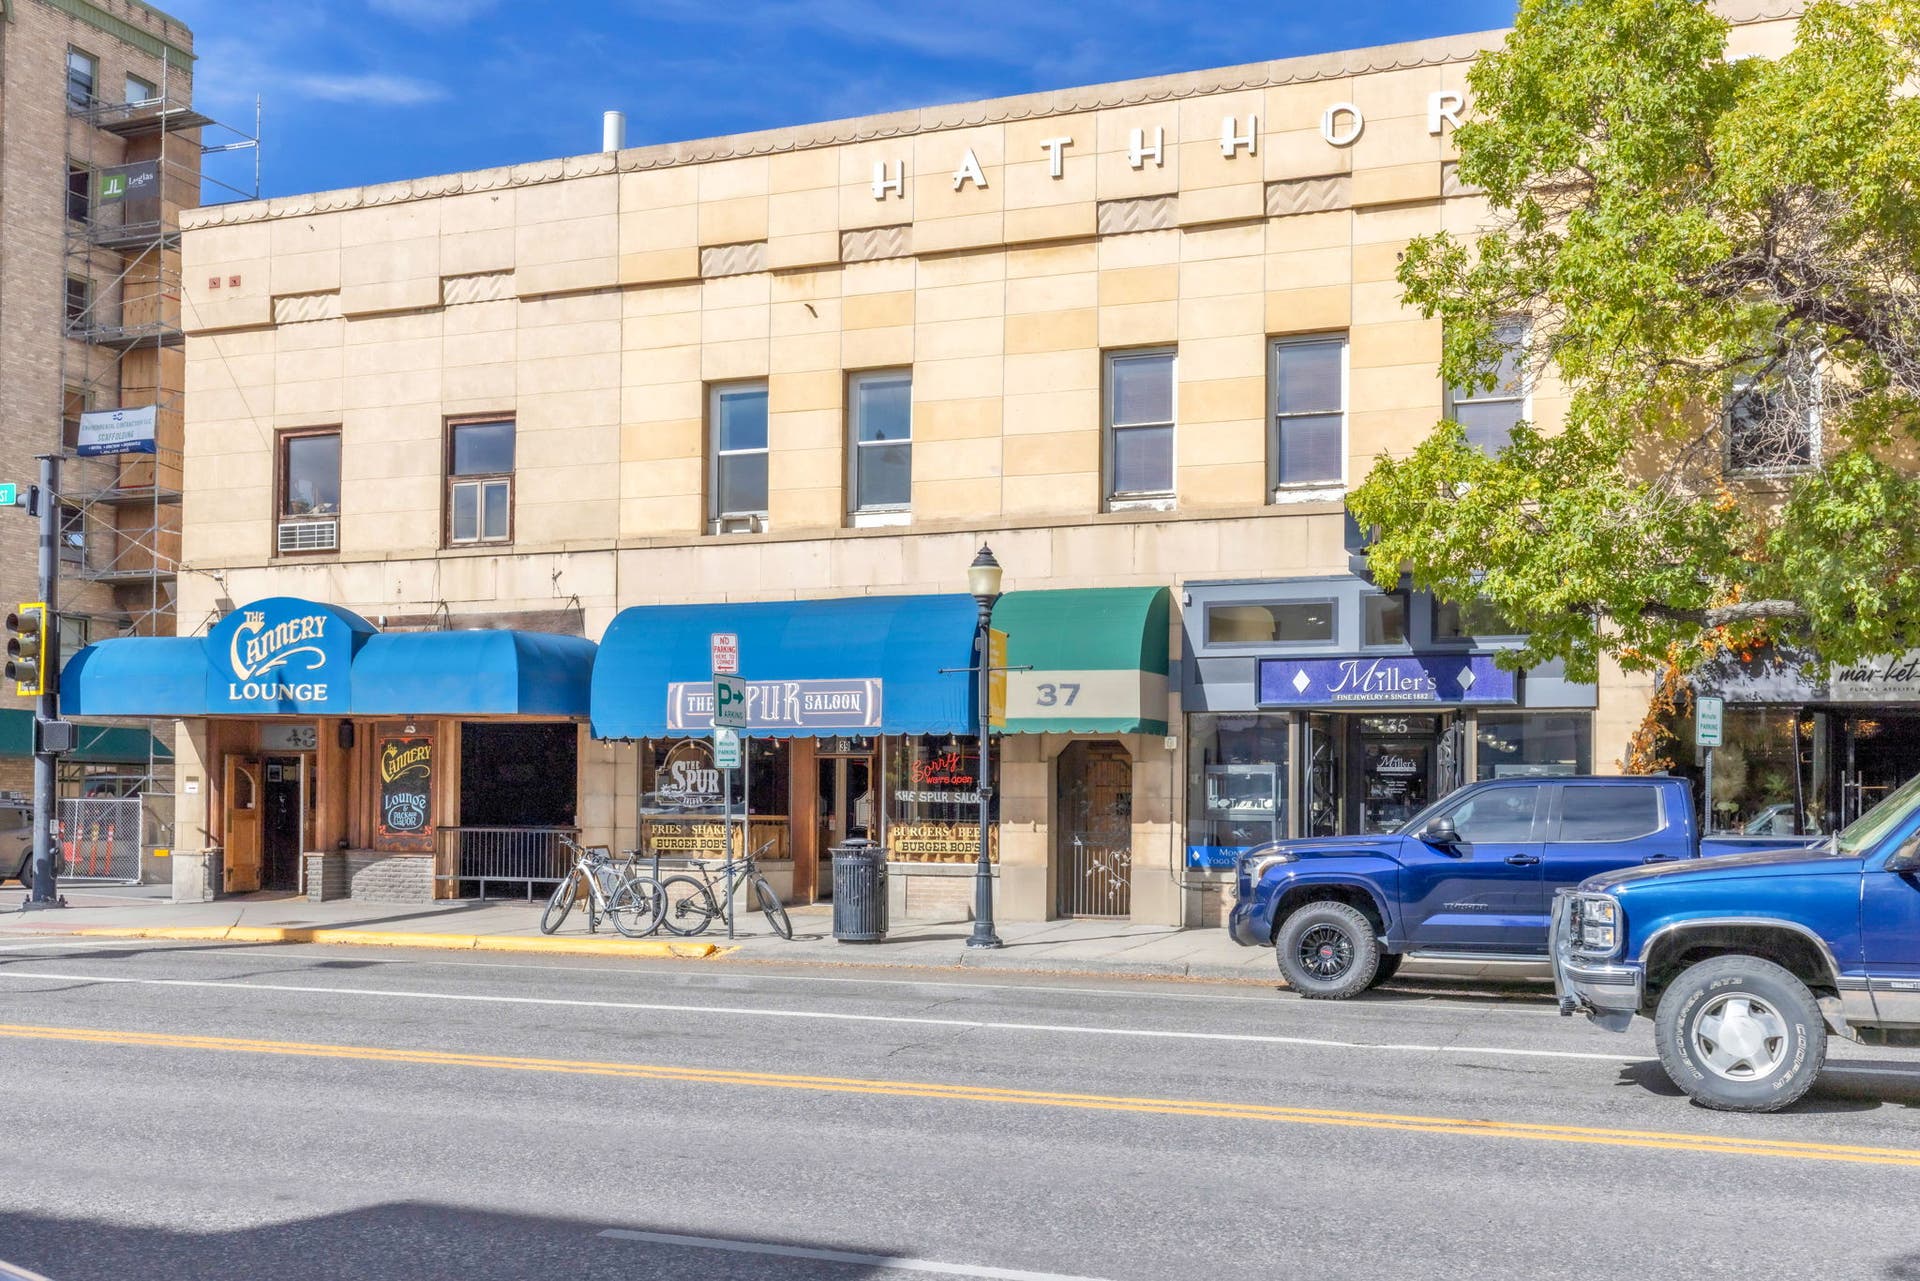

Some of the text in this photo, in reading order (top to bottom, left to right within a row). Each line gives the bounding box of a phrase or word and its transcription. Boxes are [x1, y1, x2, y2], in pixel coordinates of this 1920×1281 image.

[243, 611, 265, 622] THE
[720, 636, 730, 645] NO
[1326, 657, 1437, 692] Miller's
[229, 683, 328, 701] LOUNGE
[1036, 683, 1080, 706] 37
[1352, 693, 1383, 701] JEWELRY
[687, 696, 714, 711] THE
[804, 694, 861, 711] SALOON
[1387, 718, 1408, 734] 35
[840, 741, 849, 751] 39
[686, 761, 700, 770] THE
[912, 752, 959, 783] Sorry
[672, 761, 719, 793] SPUR
[895, 790, 916, 802] THE
[919, 791, 948, 803] SPUR
[651, 825, 682, 834] FRIES
[894, 827, 981, 837] BURGERS BEE
[656, 839, 727, 848] BURGER BOB'S
[902, 842, 981, 852] BURGER BOB'S
[1773, 1023, 1807, 1090] COOPER
